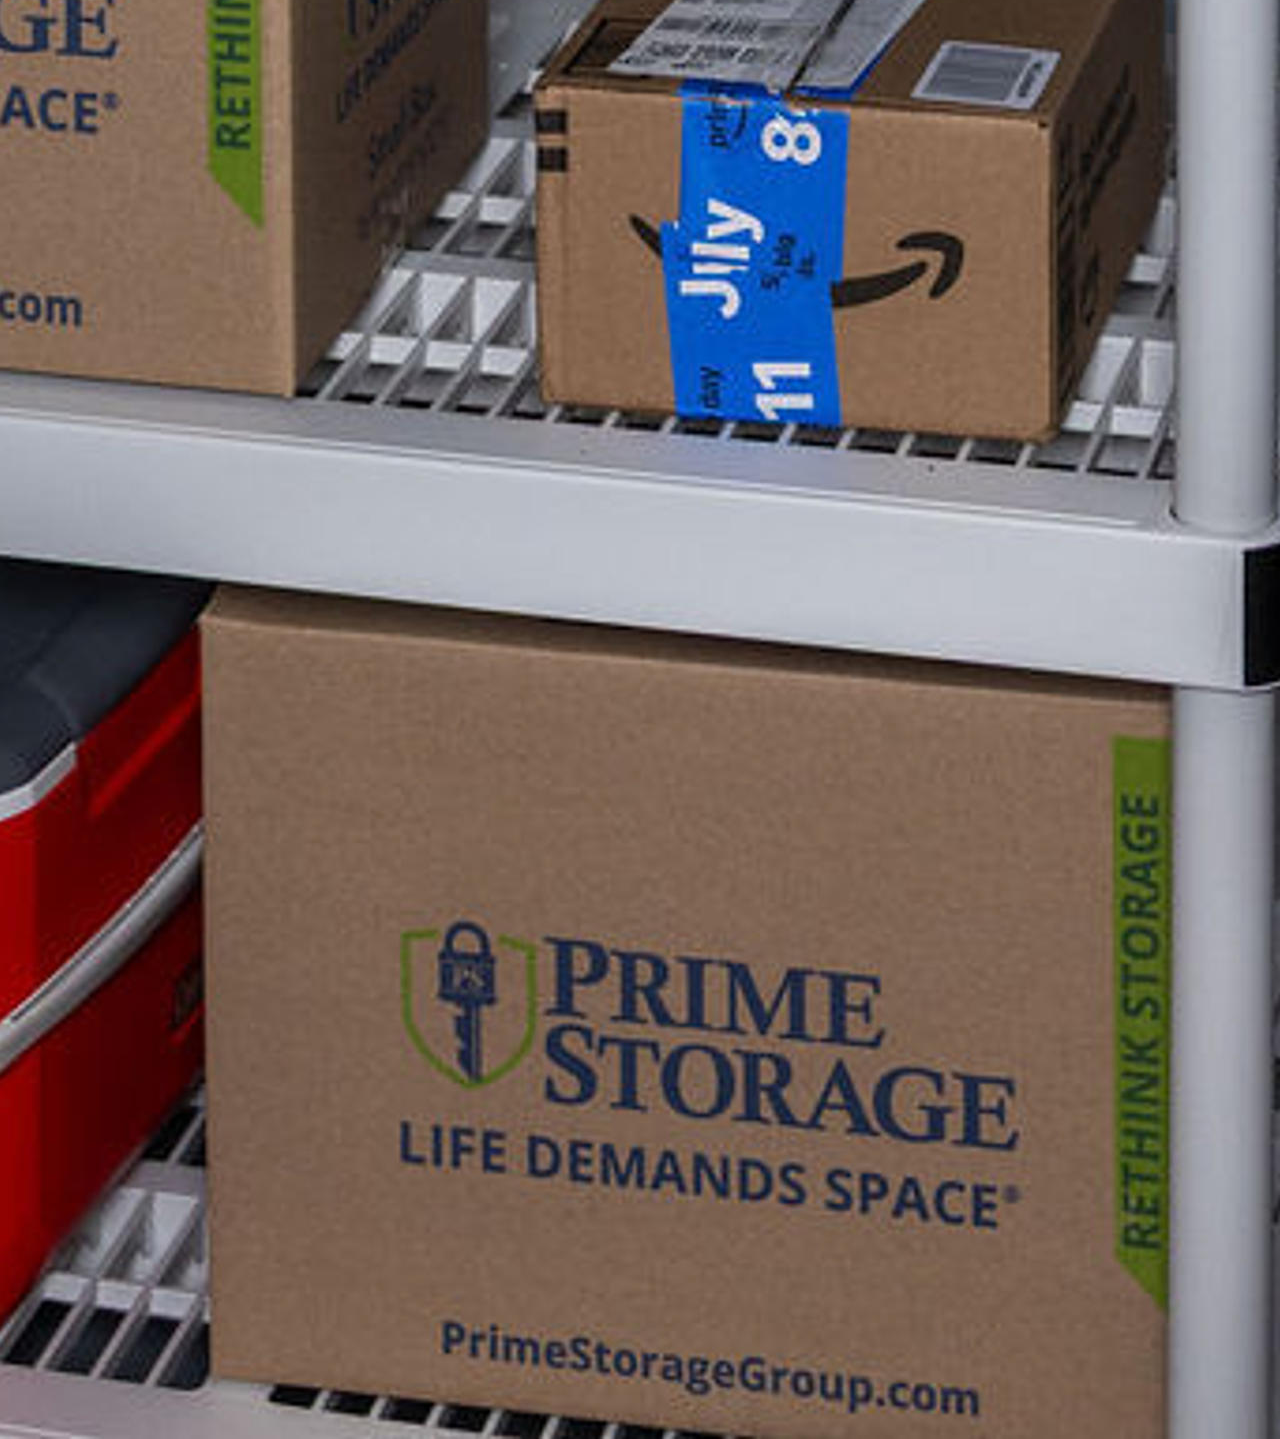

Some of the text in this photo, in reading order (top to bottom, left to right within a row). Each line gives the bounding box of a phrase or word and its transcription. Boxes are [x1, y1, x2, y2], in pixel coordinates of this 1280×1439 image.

[544, 936, 885, 1051] PRIME
[1121, 794, 1162, 1251] RETHINK STORAGE
[543, 1024, 1019, 1152] STORAGE
[400, 1121, 506, 1173] LIFE
[527, 1133, 807, 1207] DEMANDS
[440, 1321, 980, 1417] PrimeStorageGroup.com
